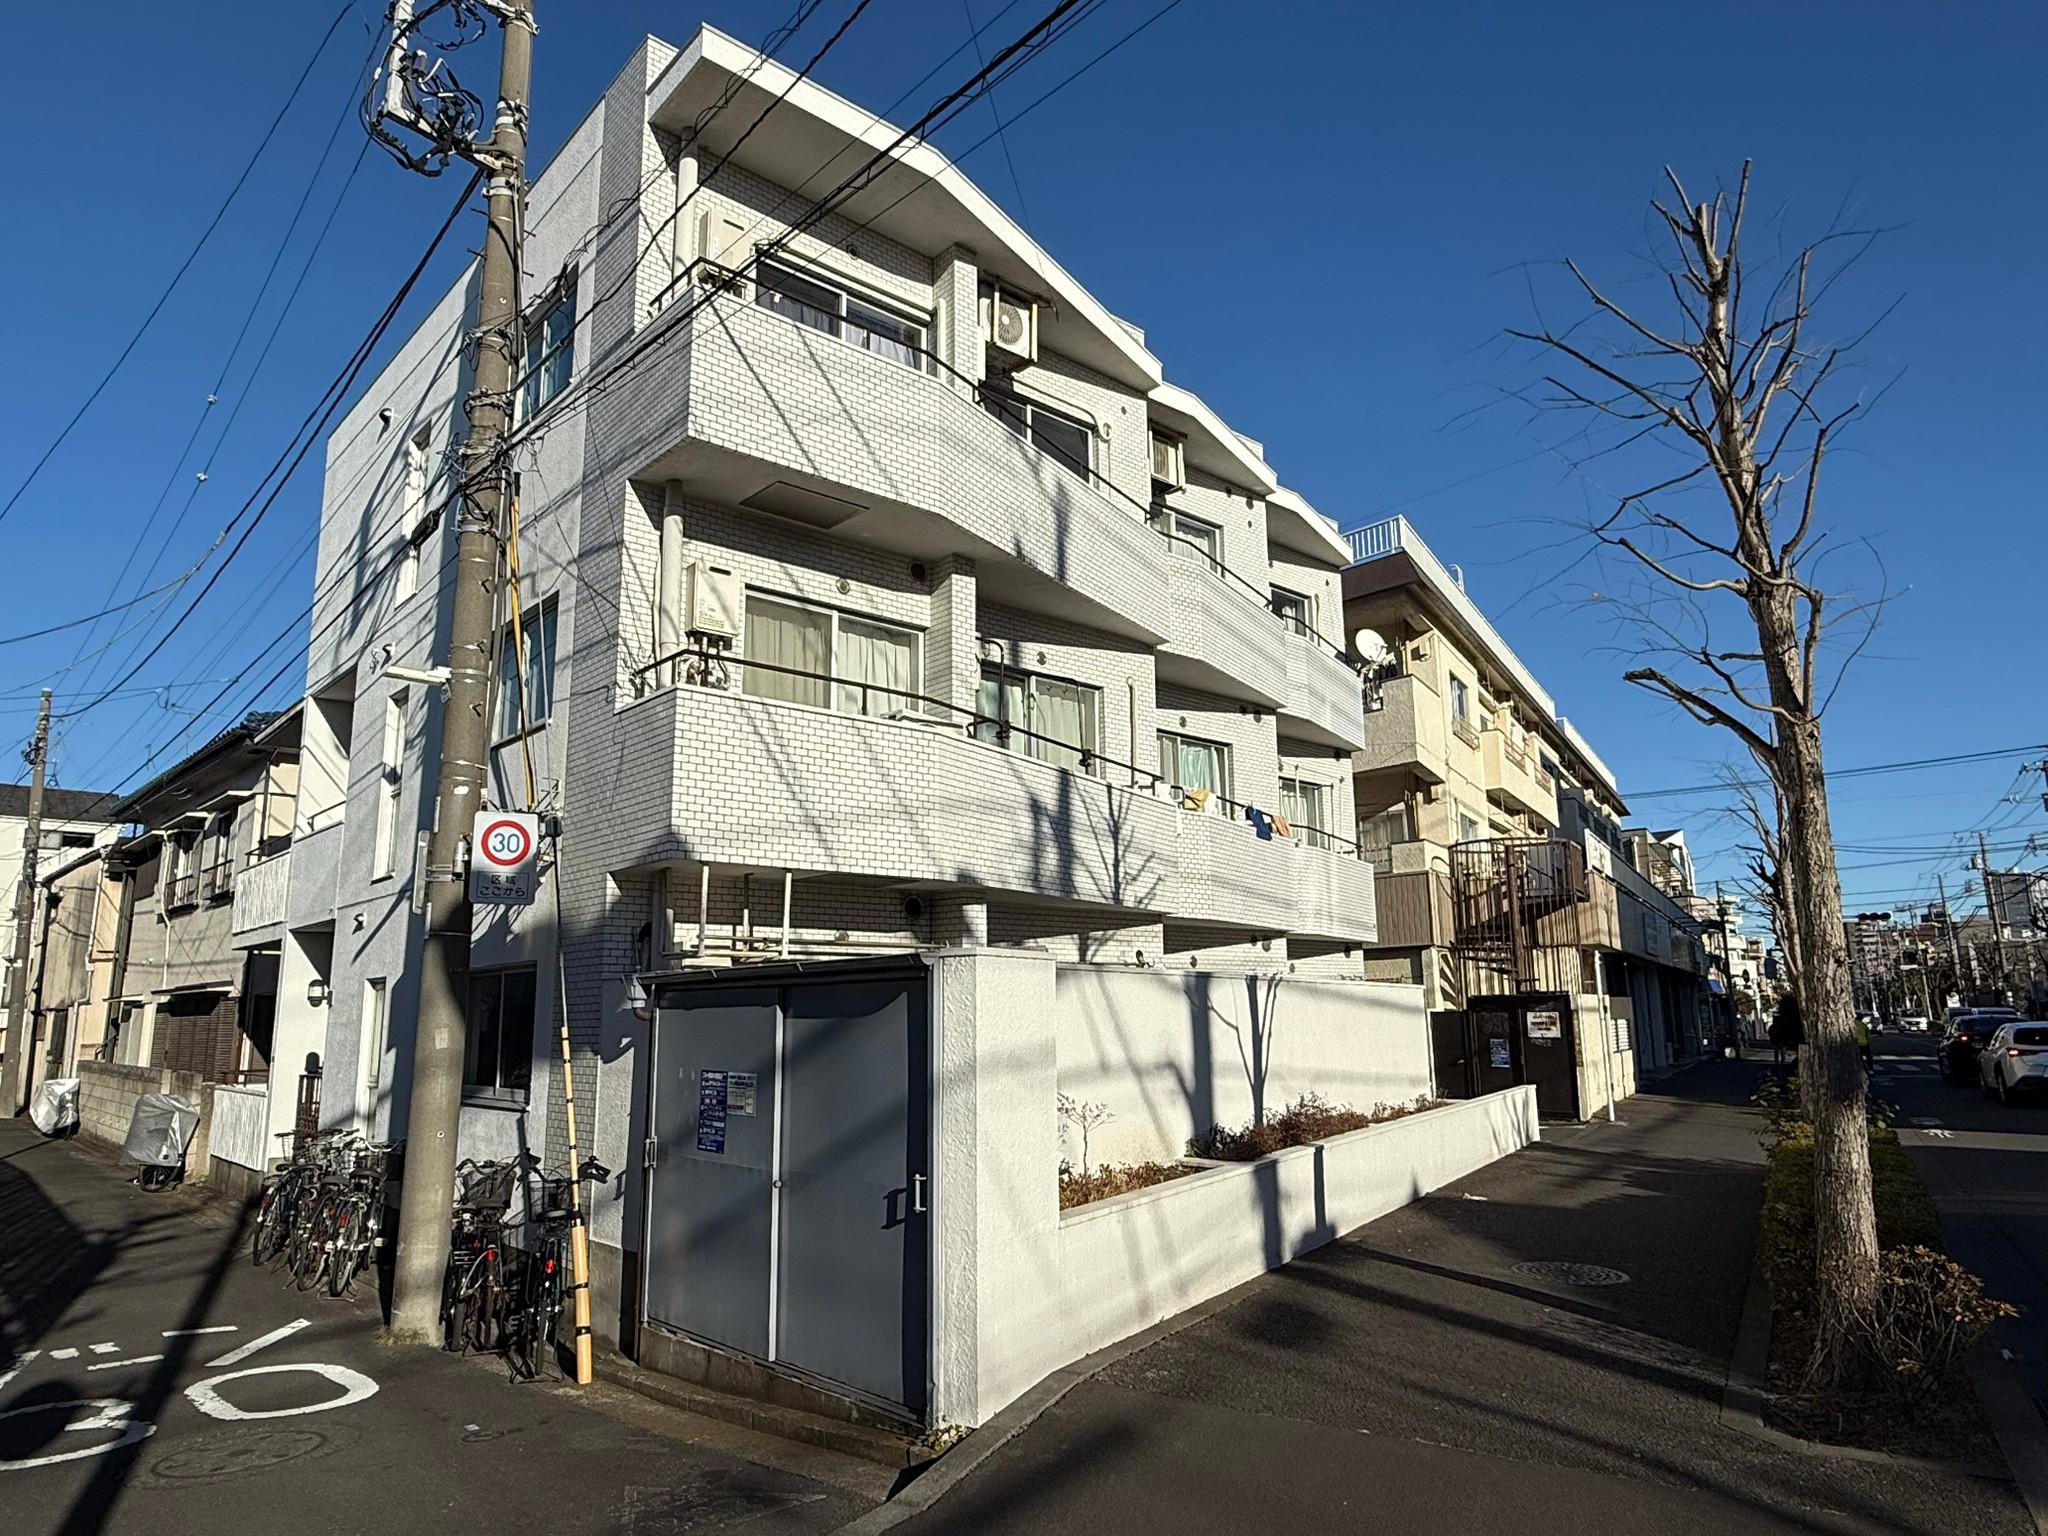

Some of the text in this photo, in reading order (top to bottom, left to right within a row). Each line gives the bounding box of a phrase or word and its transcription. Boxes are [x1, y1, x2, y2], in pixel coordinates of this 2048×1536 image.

[493, 833, 520, 853] 30
[479, 886, 526, 897] ここから
